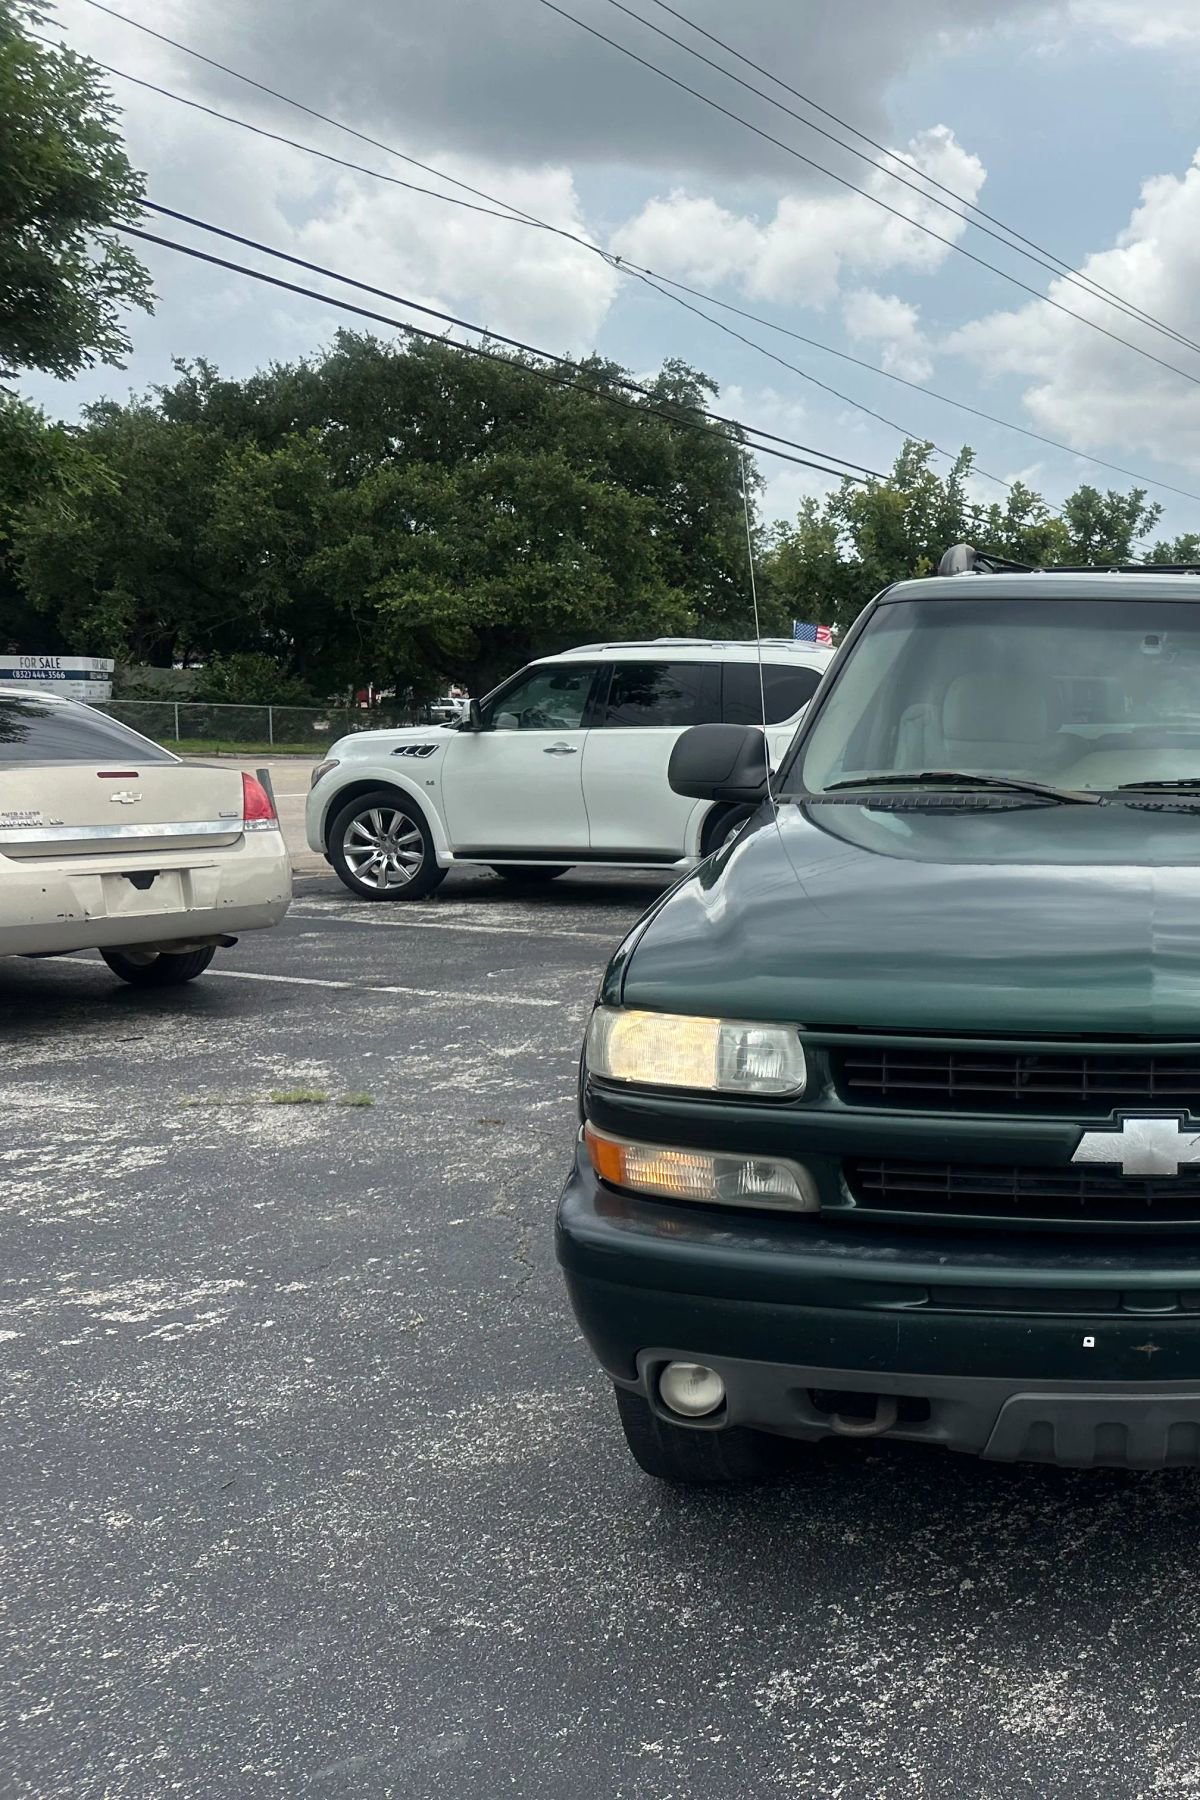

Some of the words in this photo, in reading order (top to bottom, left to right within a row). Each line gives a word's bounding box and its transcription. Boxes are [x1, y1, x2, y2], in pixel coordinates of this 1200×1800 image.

[20, 657, 37, 668] FOR
[40, 657, 61, 669] SALE
[12, 671, 31, 679] (832)
[32, 671, 66, 679] 444-3566
[0, 819, 43, 827] MPALA
